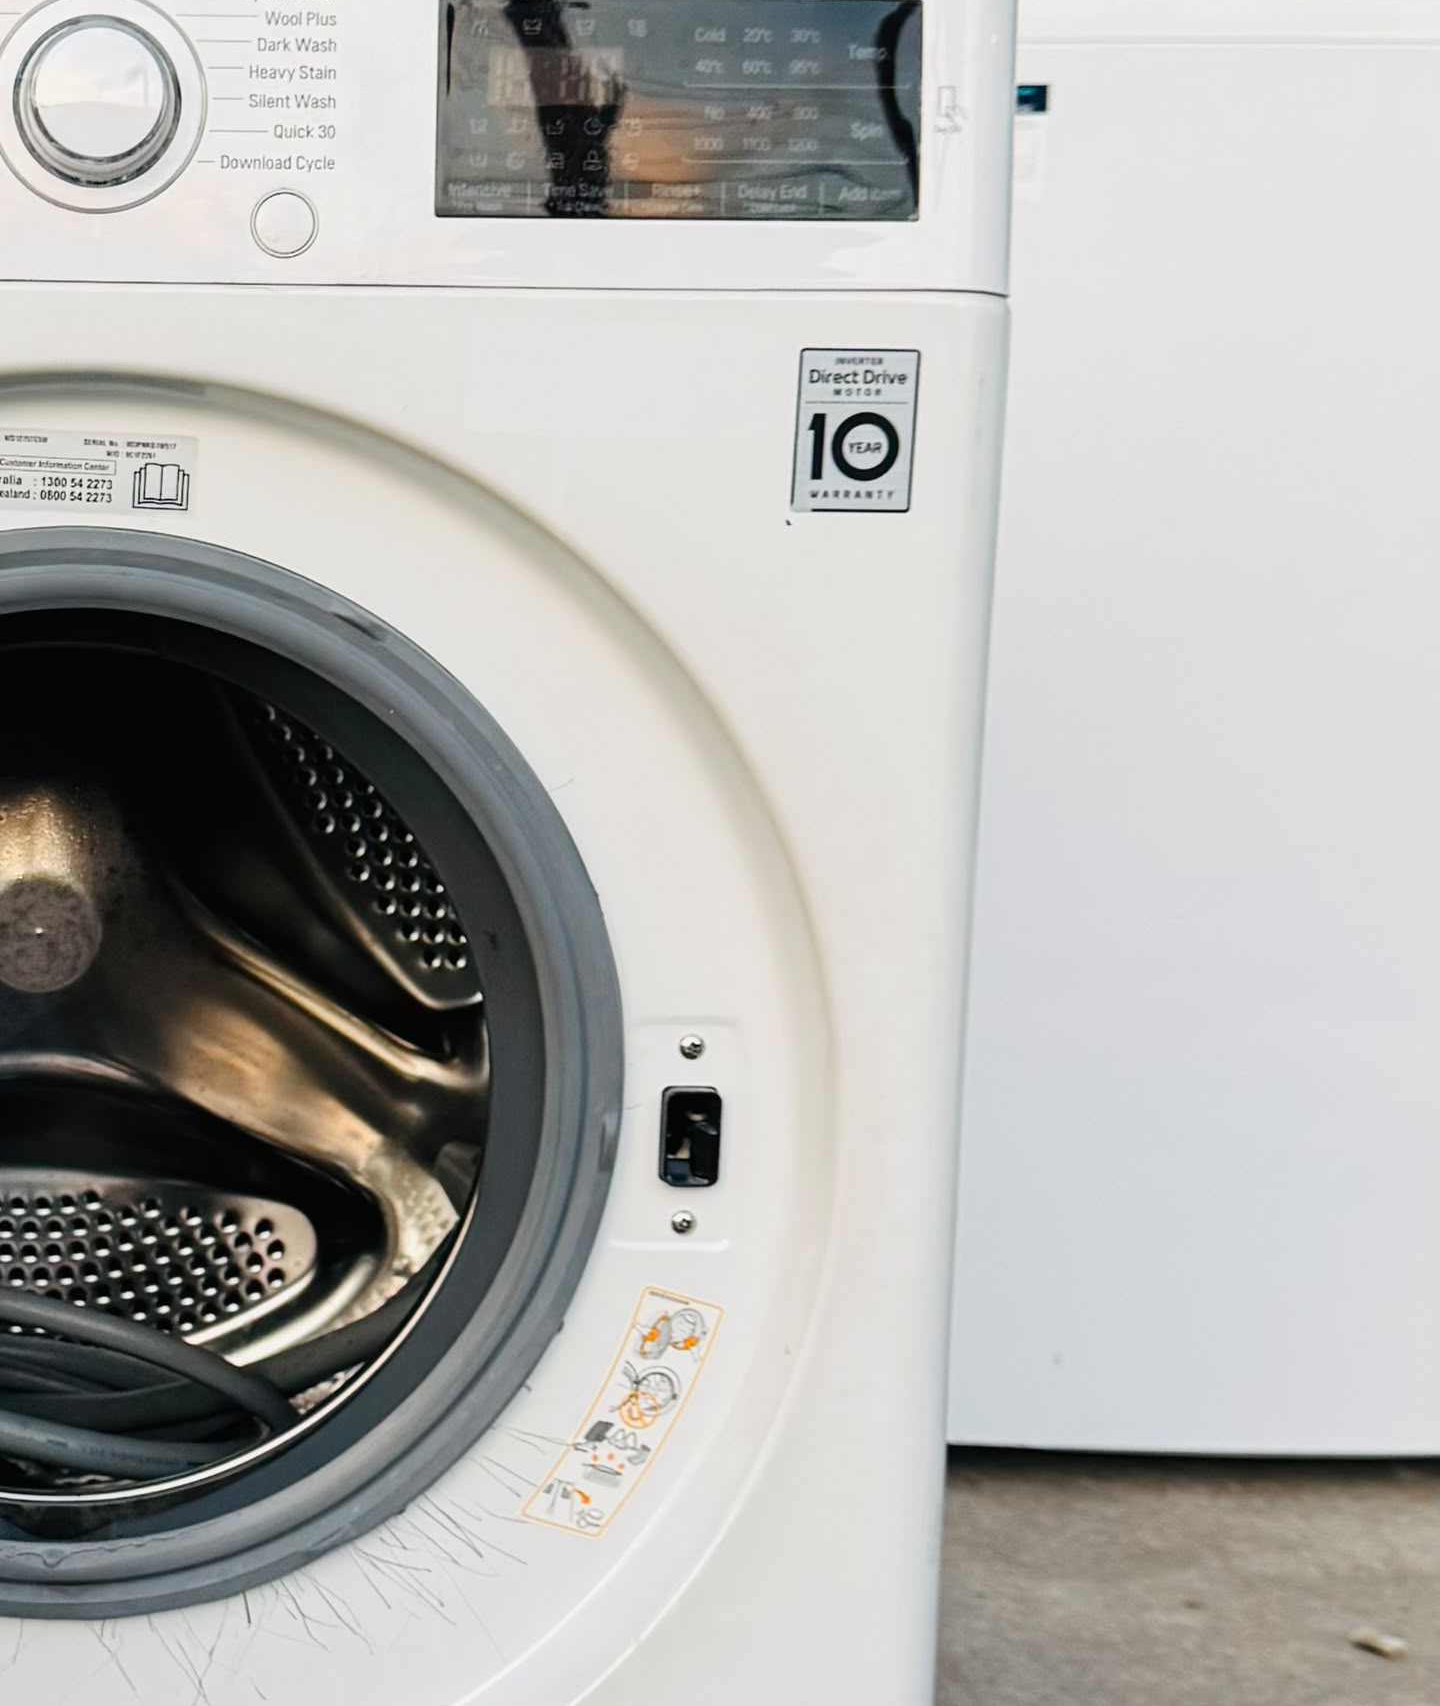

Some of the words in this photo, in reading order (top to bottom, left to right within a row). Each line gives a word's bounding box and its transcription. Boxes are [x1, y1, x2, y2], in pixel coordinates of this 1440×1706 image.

[265, 11, 302, 26] Wool
[306, 11, 337, 26] Plus
[257, 37, 291, 52] Dark
[295, 38, 336, 53] Wash
[249, 65, 295, 82] Heavy
[299, 65, 337, 80] Stain
[248, 93, 290, 108] Silent
[294, 94, 336, 109] Wash
[273, 124, 314, 139] Quick
[318, 125, 336, 139] 30
[220, 154, 292, 170] Download
[296, 155, 335, 173] Cycle
[835, 357, 884, 366] INVERTER
[809, 369, 860, 384] Direct
[863, 369, 908, 385] Drive
[832, 388, 882, 396] MOTOR
[808, 411, 900, 482] 10
[847, 442, 882, 454] YEAR
[0, 458, 37, 468] Customer
[38, 460, 82, 470] Information
[41, 476, 67, 487] 1300
[71, 478, 83, 488] 54
[86, 479, 113, 490] 2273
[40, 490, 66, 501] 0800
[70, 491, 82, 501] 54
[86, 492, 112, 503] 2273
[809, 490, 895, 500] WARRANTY
